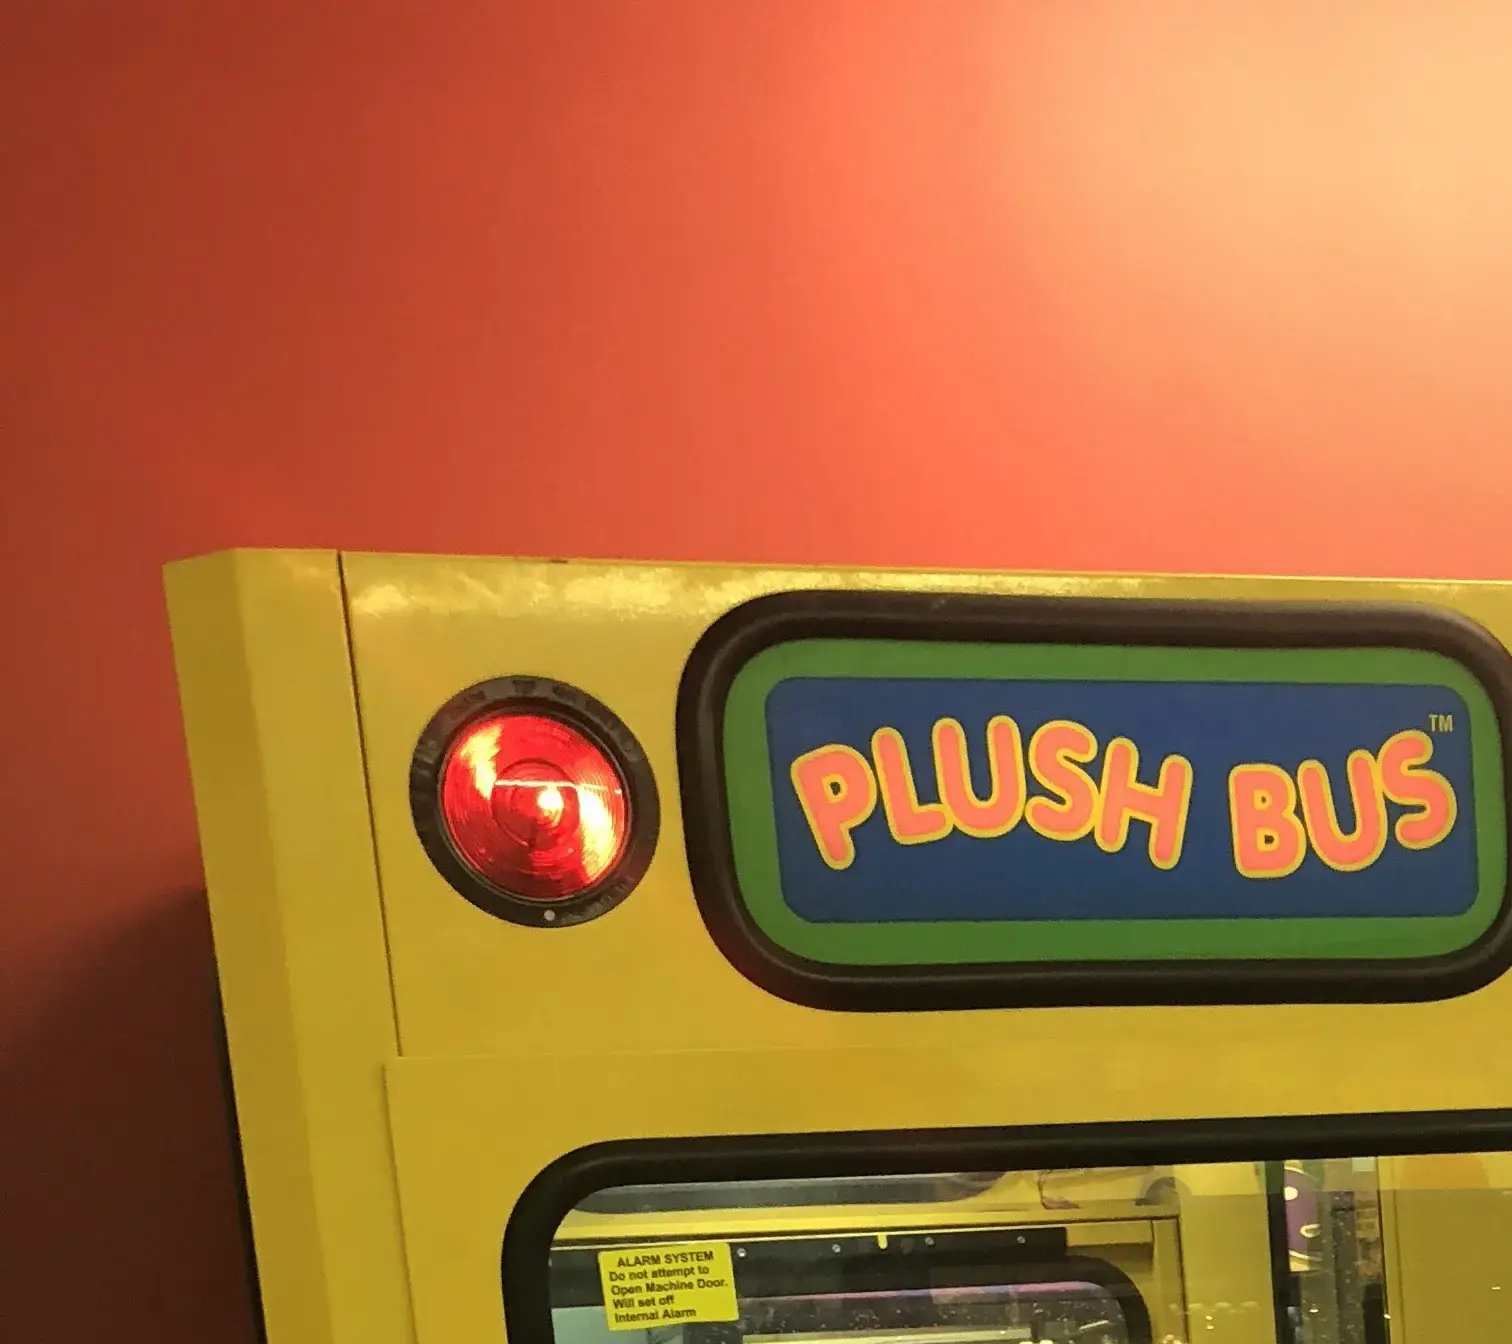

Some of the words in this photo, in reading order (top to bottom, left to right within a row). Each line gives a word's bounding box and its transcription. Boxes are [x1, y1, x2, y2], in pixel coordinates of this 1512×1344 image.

[791, 715, 1193, 871] PLUSH
[1229, 729, 1458, 878] BUS
[617, 1253, 661, 1268] ALARM
[664, 1250, 714, 1264] SYSTEM
[609, 1270, 626, 1282] Do
[629, 1270, 648, 1281] not
[651, 1266, 695, 1279] attempt
[697, 1265, 709, 1275] to
[611, 1284, 642, 1297] Open
[645, 1280, 694, 1293] Machine
[697, 1278, 729, 1289] Door.
[612, 1298, 635, 1309] Will
[638, 1297, 656, 1307] set
[658, 1295, 675, 1306] off
[614, 1311, 659, 1323] Internal
[662, 1308, 697, 1320] Alarm
